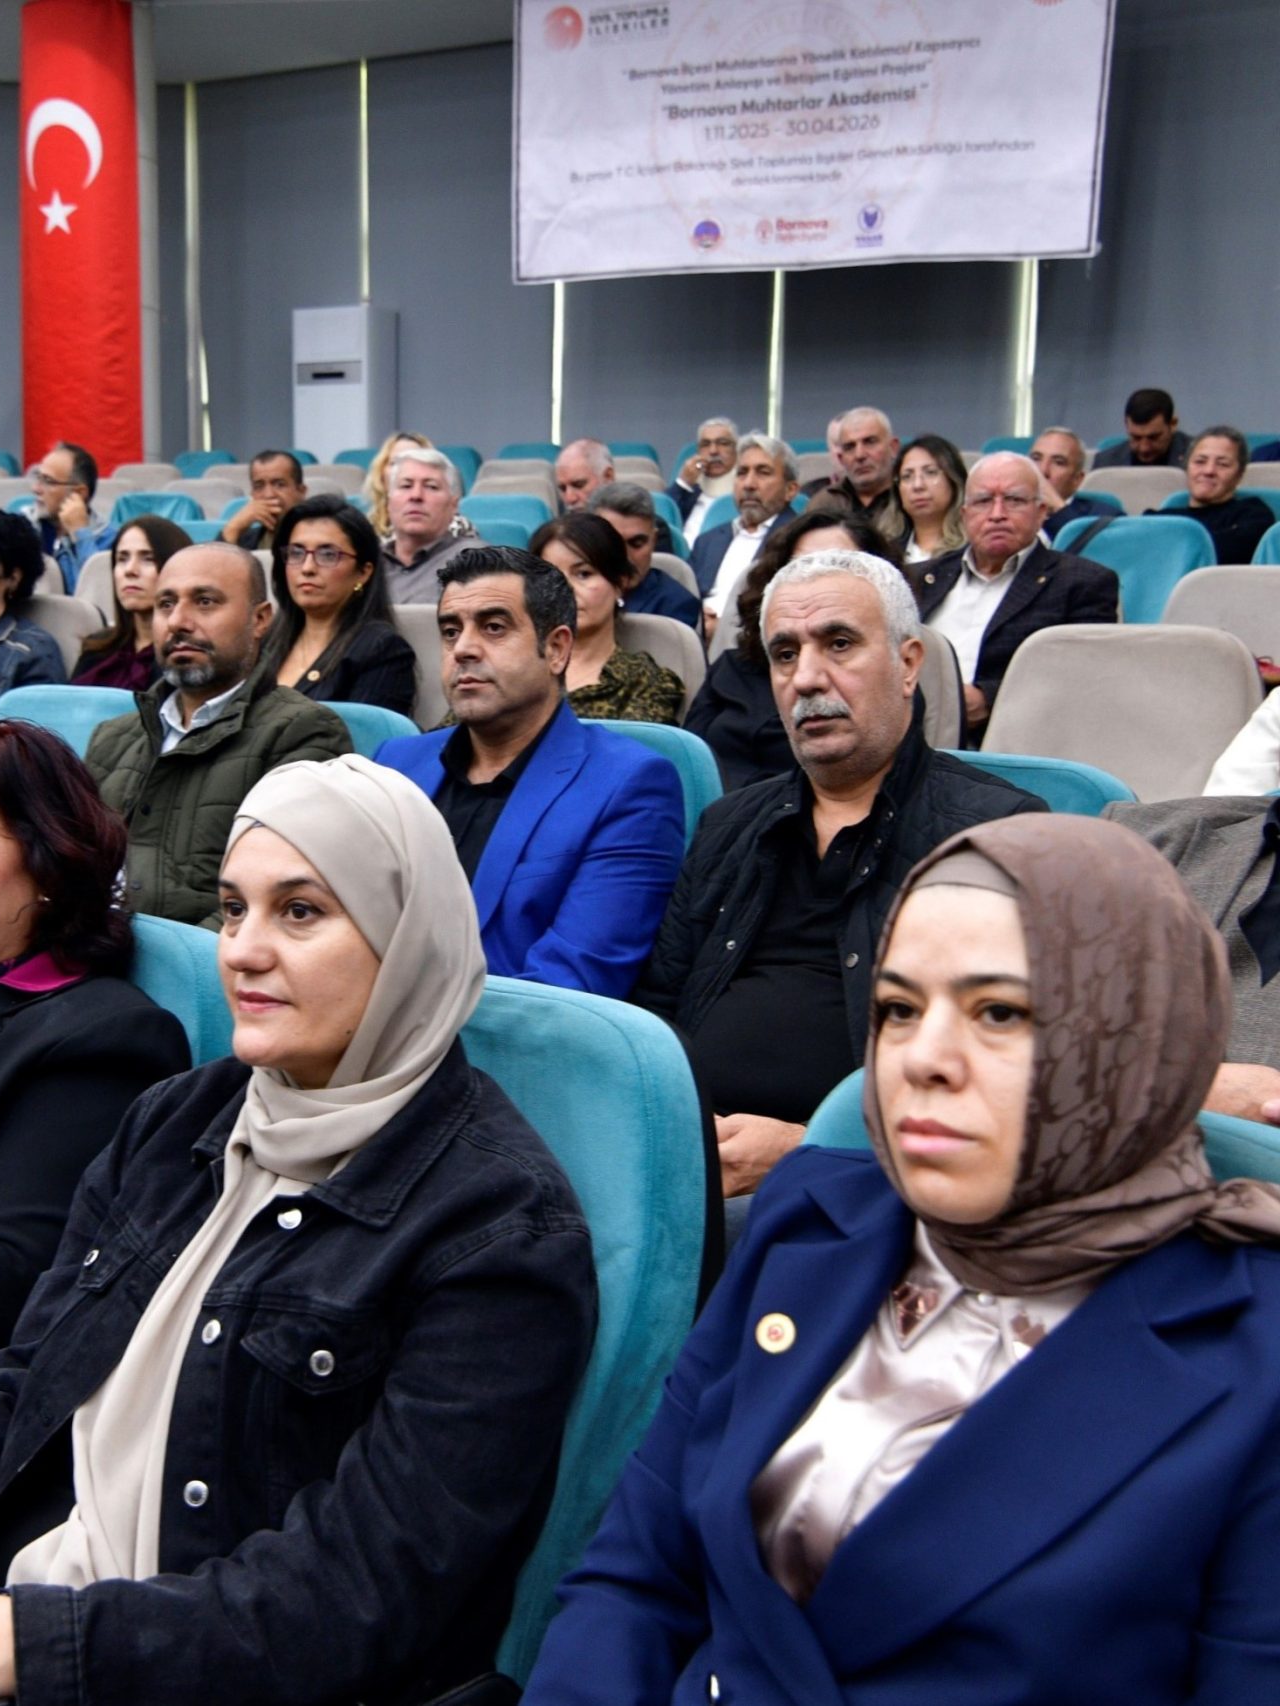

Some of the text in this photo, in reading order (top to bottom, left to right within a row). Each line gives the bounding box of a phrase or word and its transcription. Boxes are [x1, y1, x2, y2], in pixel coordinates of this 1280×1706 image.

[661, 81, 711, 95] Yönetim
[766, 76, 781, 86] ve
[662, 102, 737, 120] "Bornova
[741, 95, 823, 114] Muhtarlar
[828, 86, 917, 108] Akademisi
[786, 114, 881, 136] 30.04.2026
[776, 217, 829, 231] Bornova
